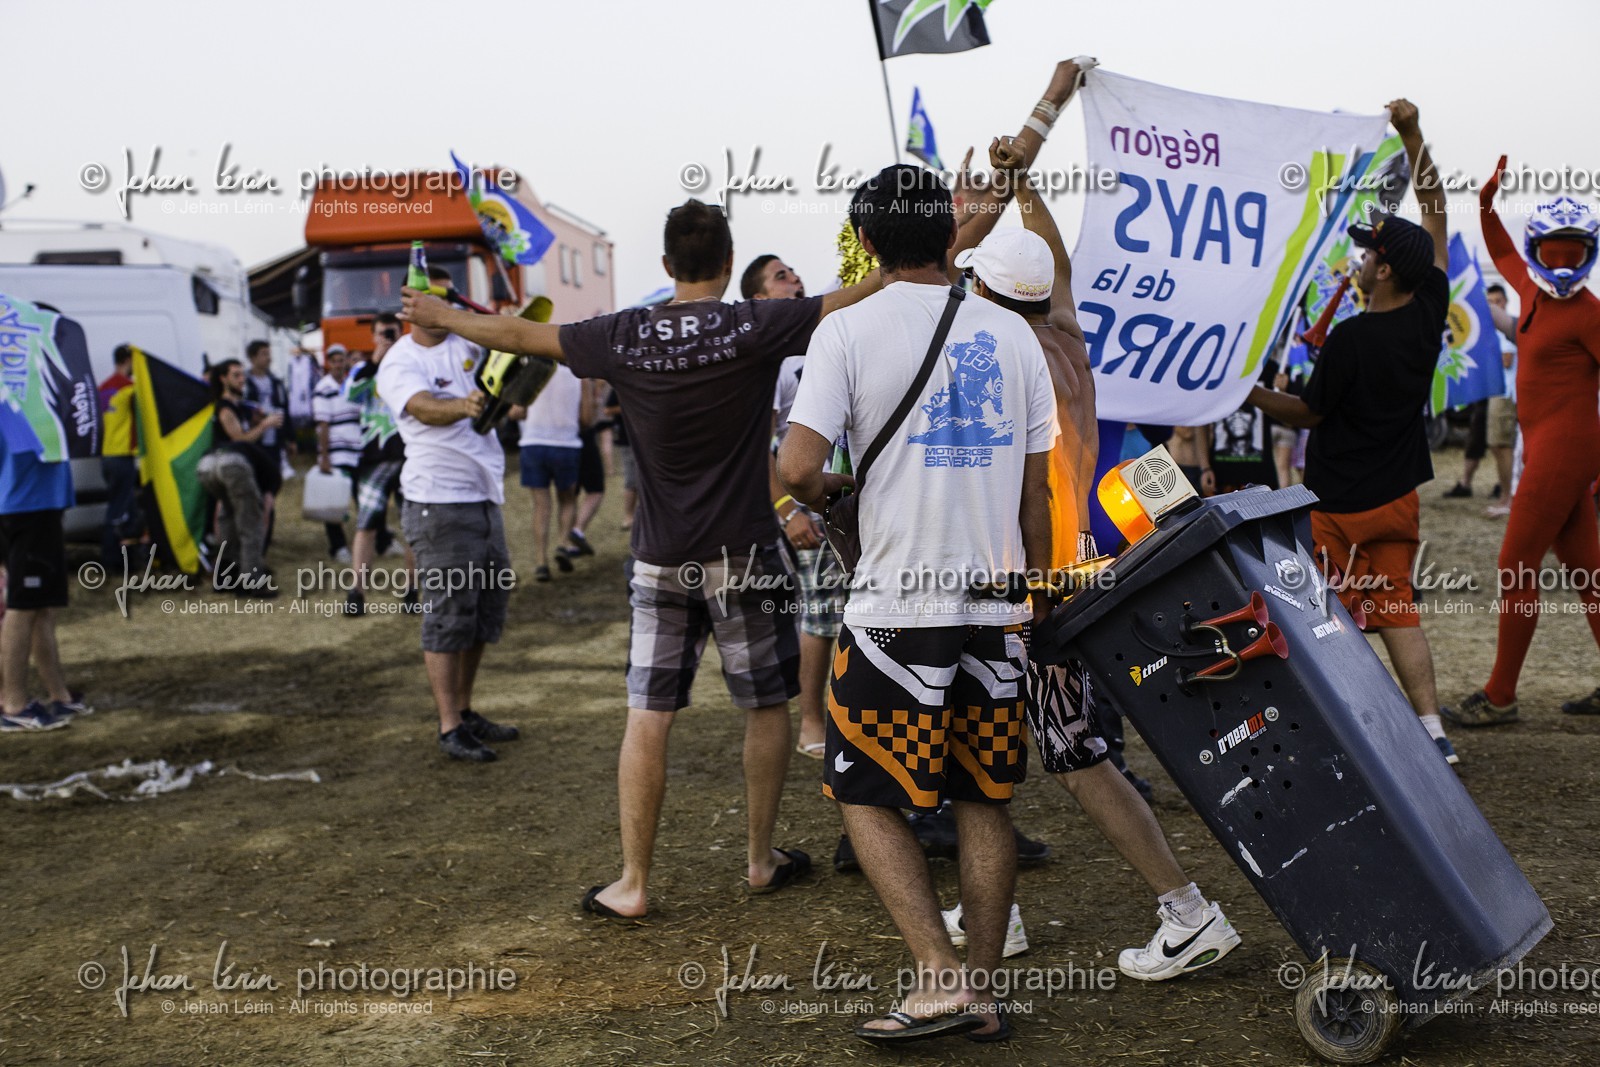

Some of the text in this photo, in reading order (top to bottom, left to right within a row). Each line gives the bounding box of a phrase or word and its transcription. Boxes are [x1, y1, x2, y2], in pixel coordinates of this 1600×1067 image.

[698, 346, 737, 367] RAW
[960, 349, 996, 373] 15
[956, 447, 993, 456] CROSS
[924, 456, 993, 468] SEVERAC
